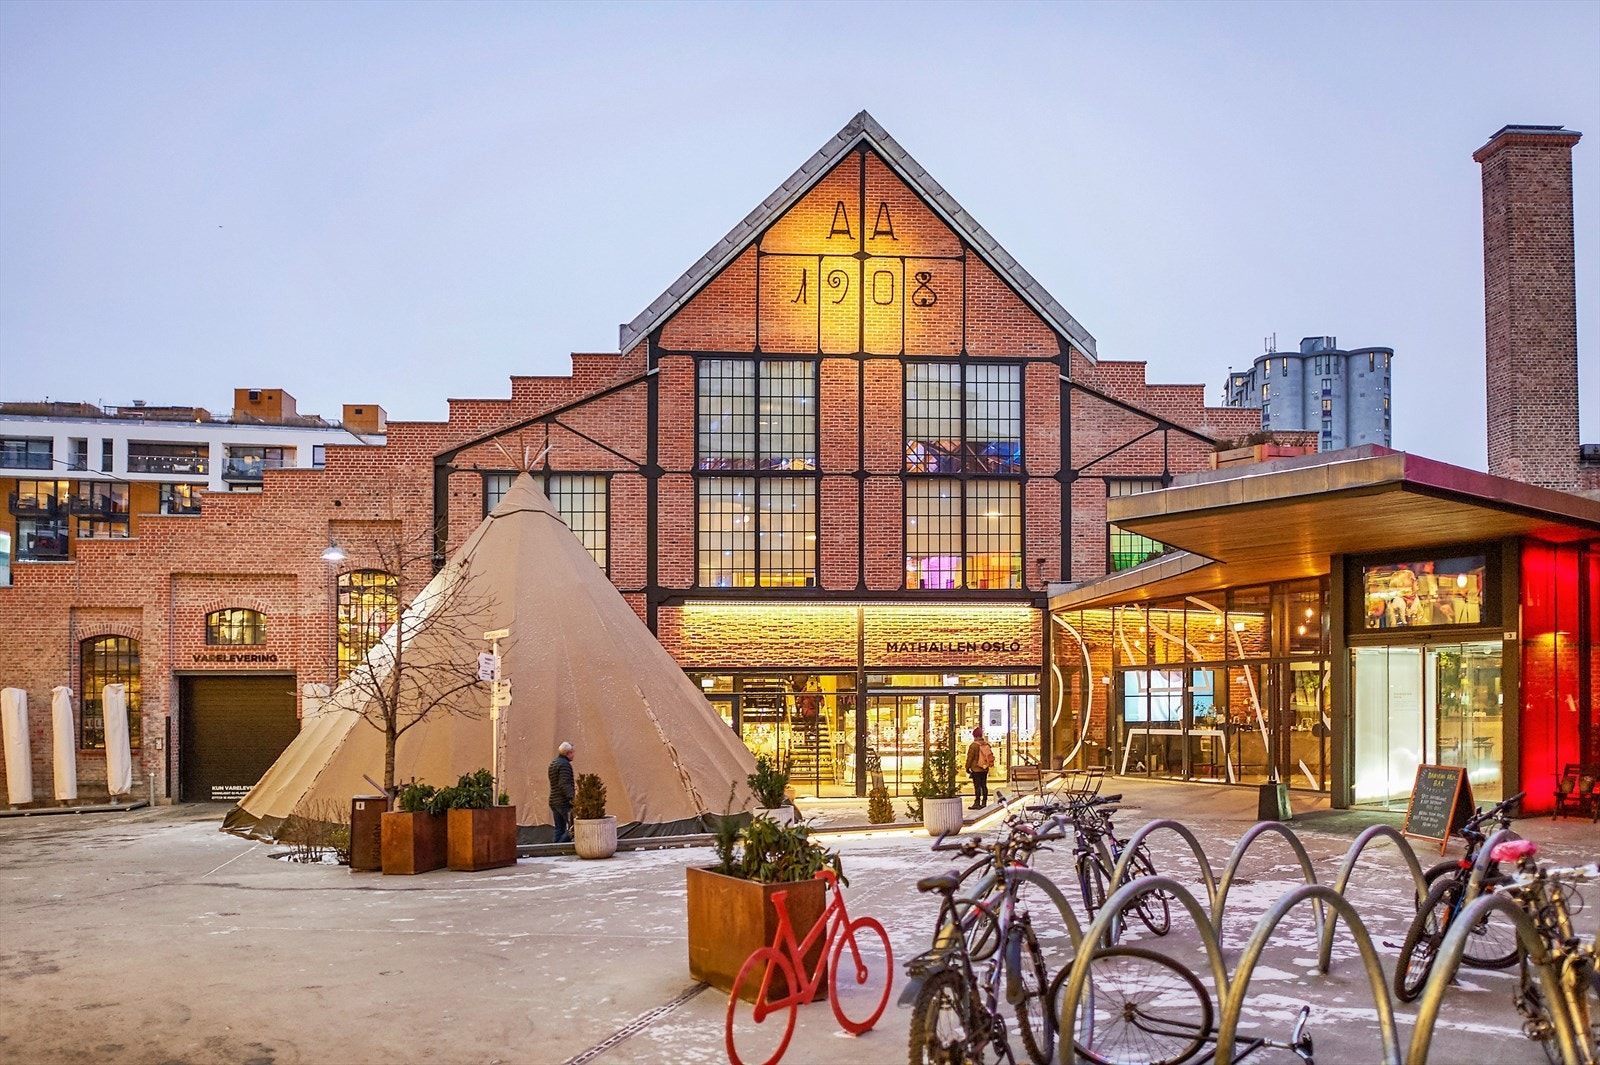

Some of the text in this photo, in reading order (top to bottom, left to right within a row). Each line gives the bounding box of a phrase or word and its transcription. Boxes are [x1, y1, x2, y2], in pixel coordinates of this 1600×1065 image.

[826, 201, 899, 241] A A
[790, 268, 938, 307] 1908
[192, 654, 278, 663] VARELEVERING
[886, 641, 1021, 653] MATHALLEN OSLO
